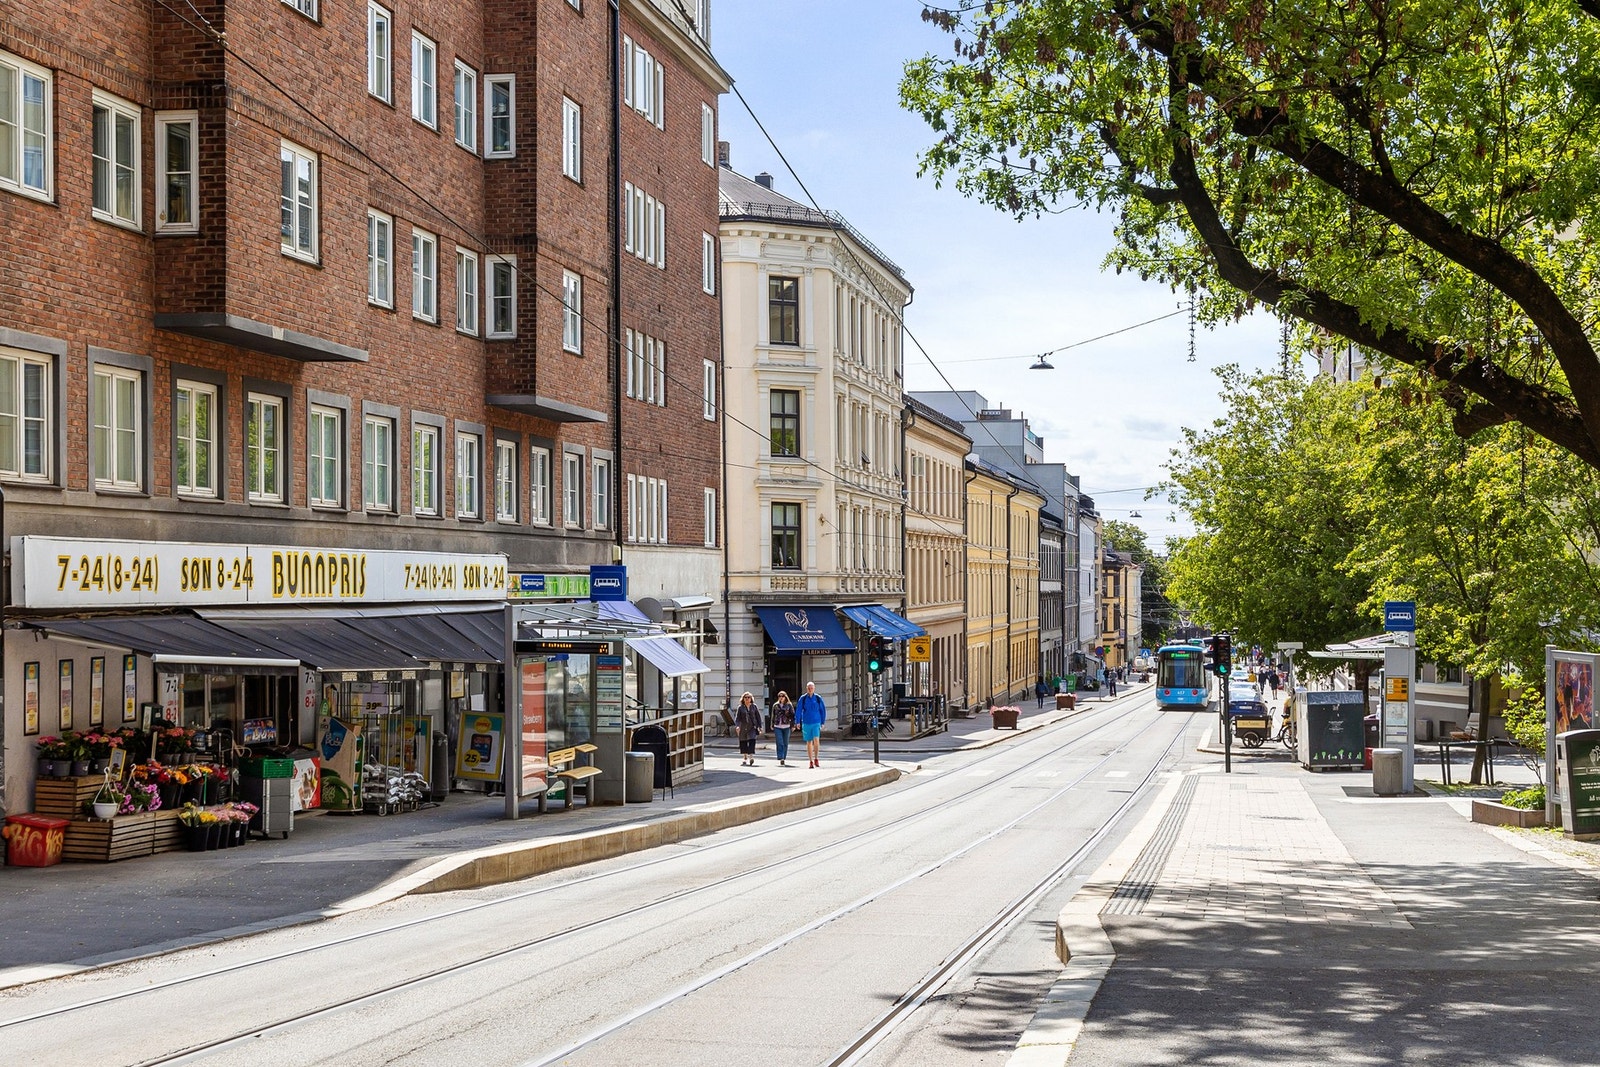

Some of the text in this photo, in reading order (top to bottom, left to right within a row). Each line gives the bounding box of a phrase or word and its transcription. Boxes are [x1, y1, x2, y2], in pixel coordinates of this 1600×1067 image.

[57, 554, 254, 594] 7-24(8-24) SØN 8-24
[272, 551, 366, 598] BUNNPRIS
[463, 564, 481, 591] SØN
[483, 564, 505, 590] 8-24
